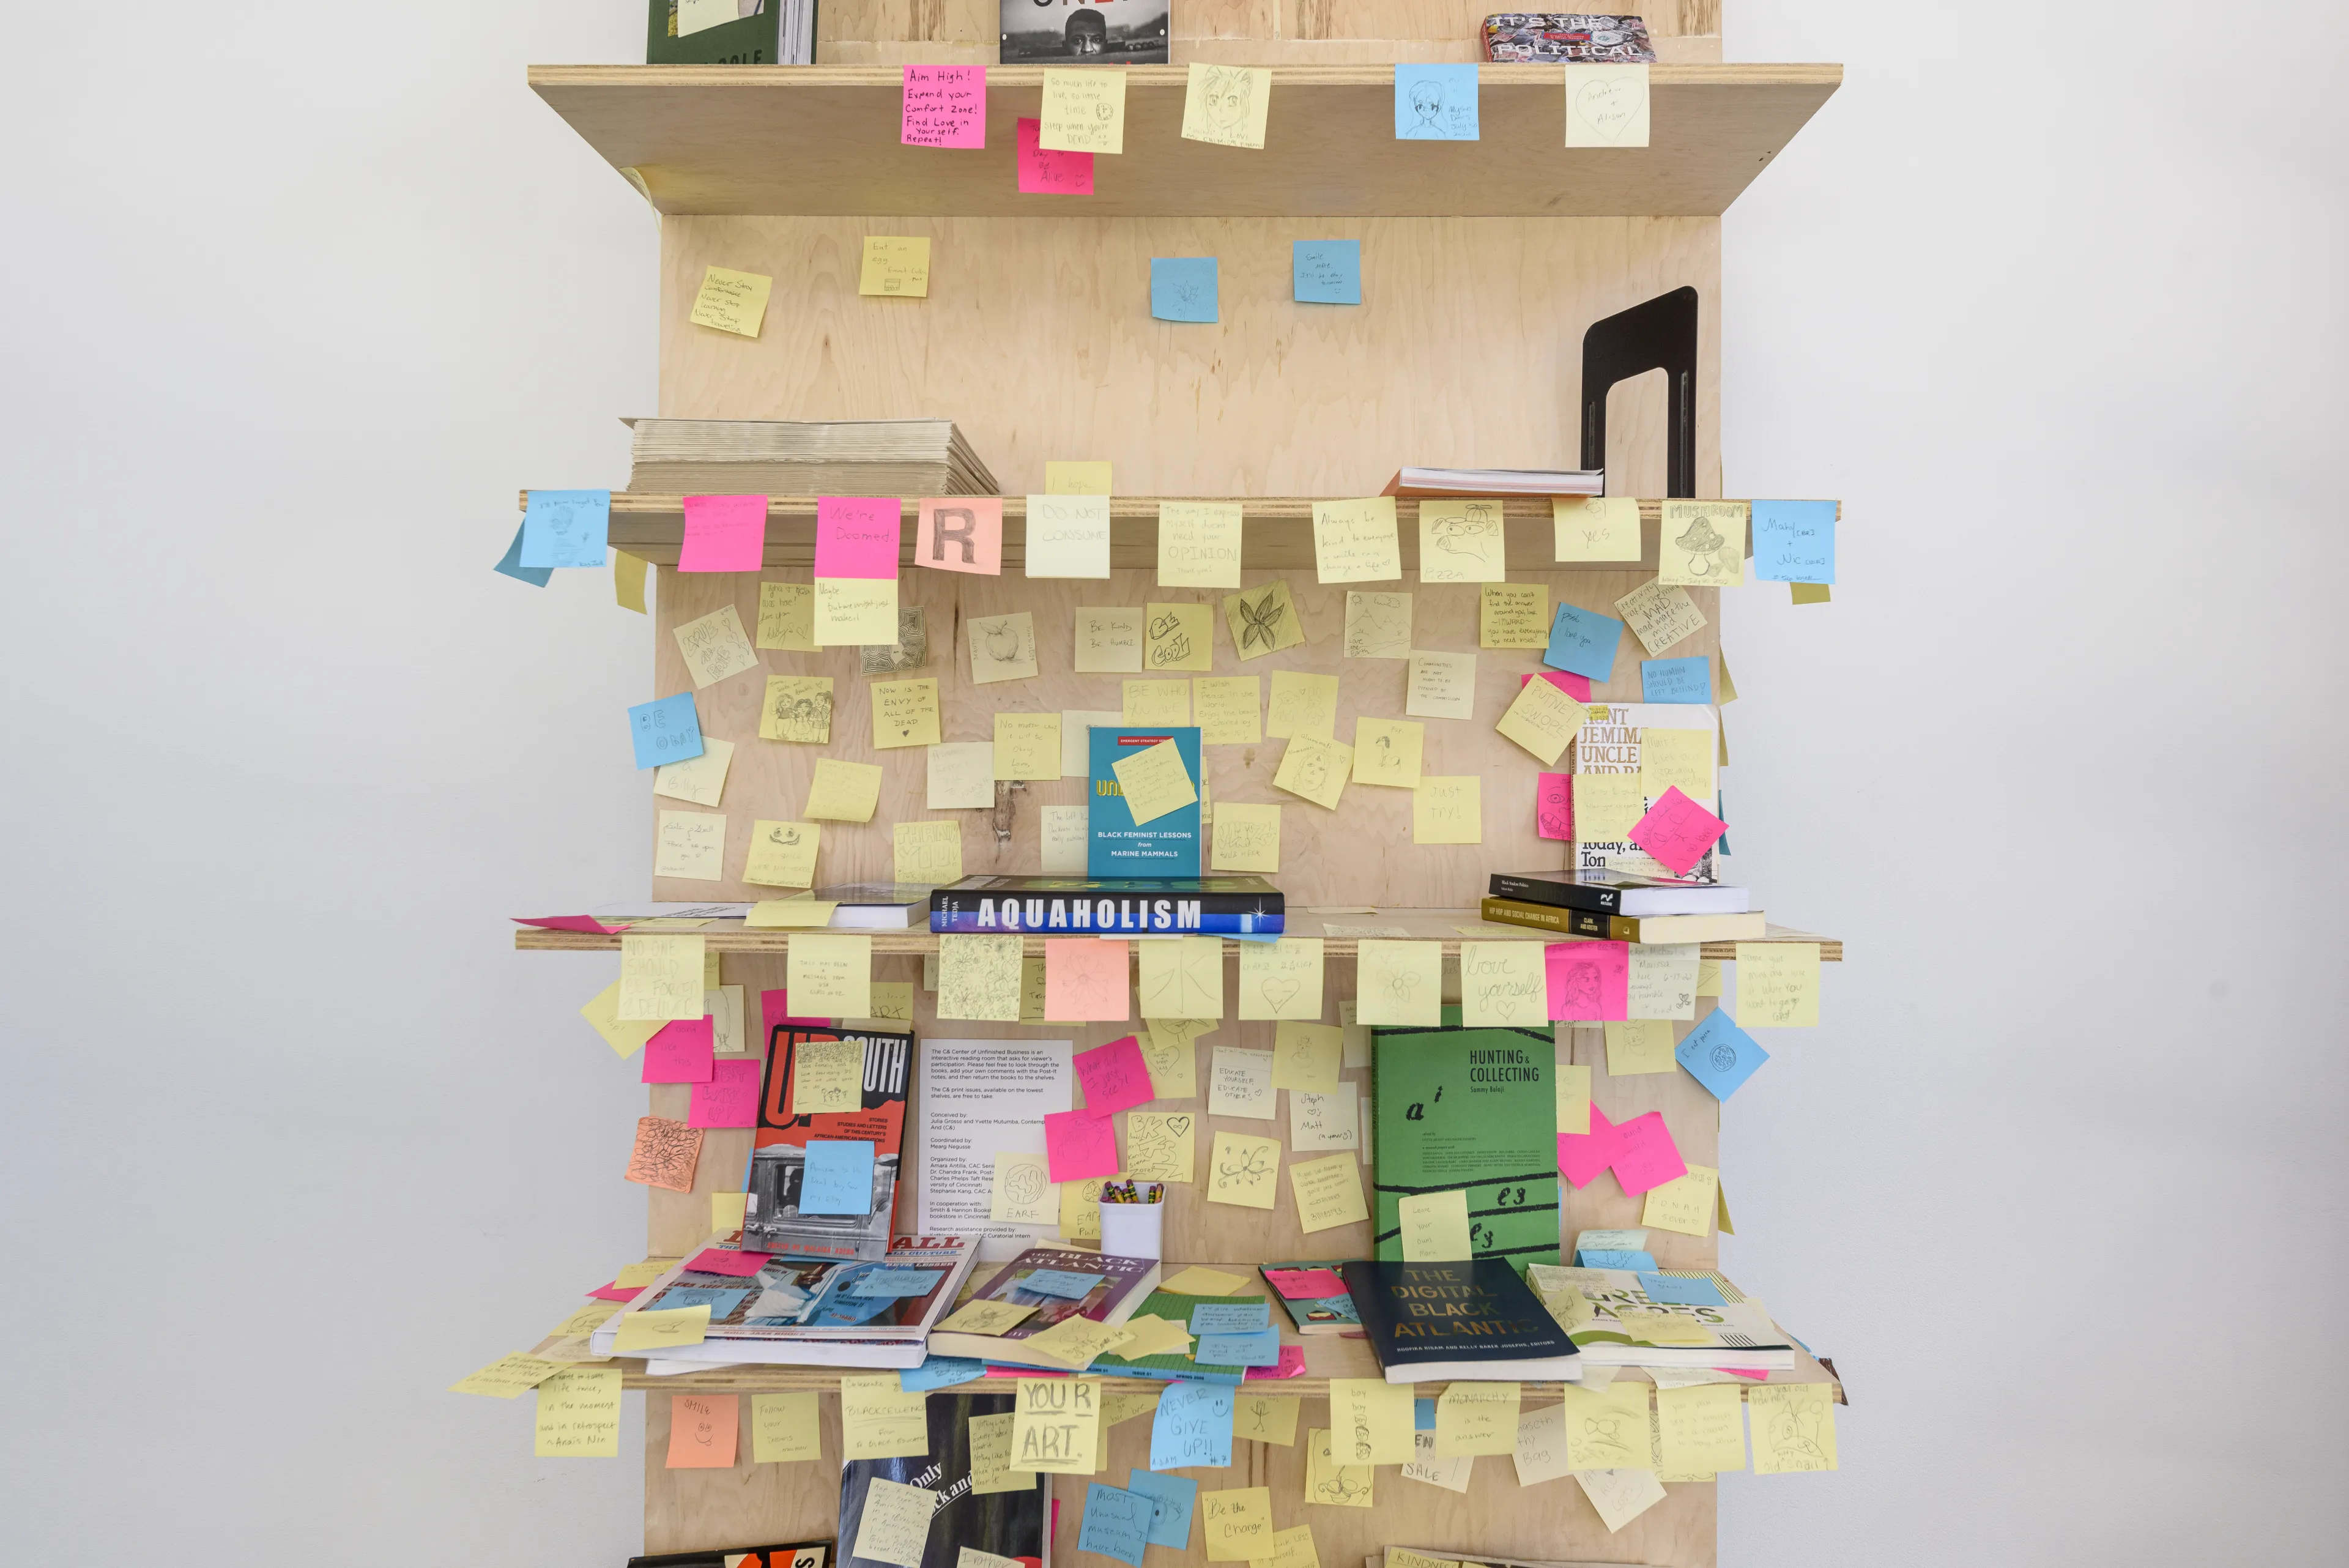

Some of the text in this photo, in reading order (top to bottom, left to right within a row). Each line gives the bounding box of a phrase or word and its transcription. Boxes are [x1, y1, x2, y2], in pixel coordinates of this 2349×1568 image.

[1493, 17, 1602, 28] IT'S THE
[1499, 45, 1643, 56] POLITICAL
[910, 69, 929, 82] Aim
[908, 89, 972, 102] Expand your
[905, 104, 944, 114] Comfort
[907, 116, 969, 127] Find Love in
[907, 135, 942, 146] Repeat!
[873, 242, 889, 251] Eat
[707, 274, 732, 288] Never
[699, 293, 721, 303] Never
[829, 505, 875, 522] We're
[1041, 504, 1108, 521] DO NOT
[1669, 504, 1744, 518] MUSHROOM
[836, 526, 894, 542] Doomed.
[933, 508, 978, 564] R
[1042, 530, 1108, 542] CONSUME
[1168, 546, 1238, 562] OPINION
[1485, 587, 1504, 597] When
[1647, 614, 1701, 653] CREATIVE
[1647, 669, 1657, 678] NO
[1646, 676, 1686, 689] SHOULD BE
[1158, 683, 1187, 697] WHO
[1651, 686, 1668, 697] LEFT
[883, 697, 911, 706] ENVY
[1531, 685, 1580, 723] PUTNEY
[894, 718, 919, 727] DEAD.
[1521, 703, 1572, 738] SWOPE
[1580, 727, 1646, 744] JEMIM
[1581, 746, 1638, 763] UNCLE
[896, 824, 959, 845] THANK
[978, 898, 1201, 929] AQUAHOLISM
[1525, 912, 1540, 921] CHANGE
[1545, 915, 1559, 924] AFRICA
[1470, 1050, 1523, 1065] HUNTING
[1220, 1068, 1246, 1076] EDUCATE
[1470, 1067, 1540, 1082] COLLECTING
[1025, 1258, 1144, 1273] ATLANTIC
[1058, 1252, 1138, 1265] BLACK
[1405, 1270, 1461, 1282] THE
[1391, 1285, 1498, 1298] DIGITAL
[1408, 1302, 1502, 1317] BLACK
[1395, 1318, 1539, 1338] ATLANTIC
[1160, 1388, 1210, 1418] NEVER
[1449, 1392, 1509, 1405] MONARCHY
[1170, 1416, 1210, 1436] GIVE
[910, 1462, 943, 1490] Only
